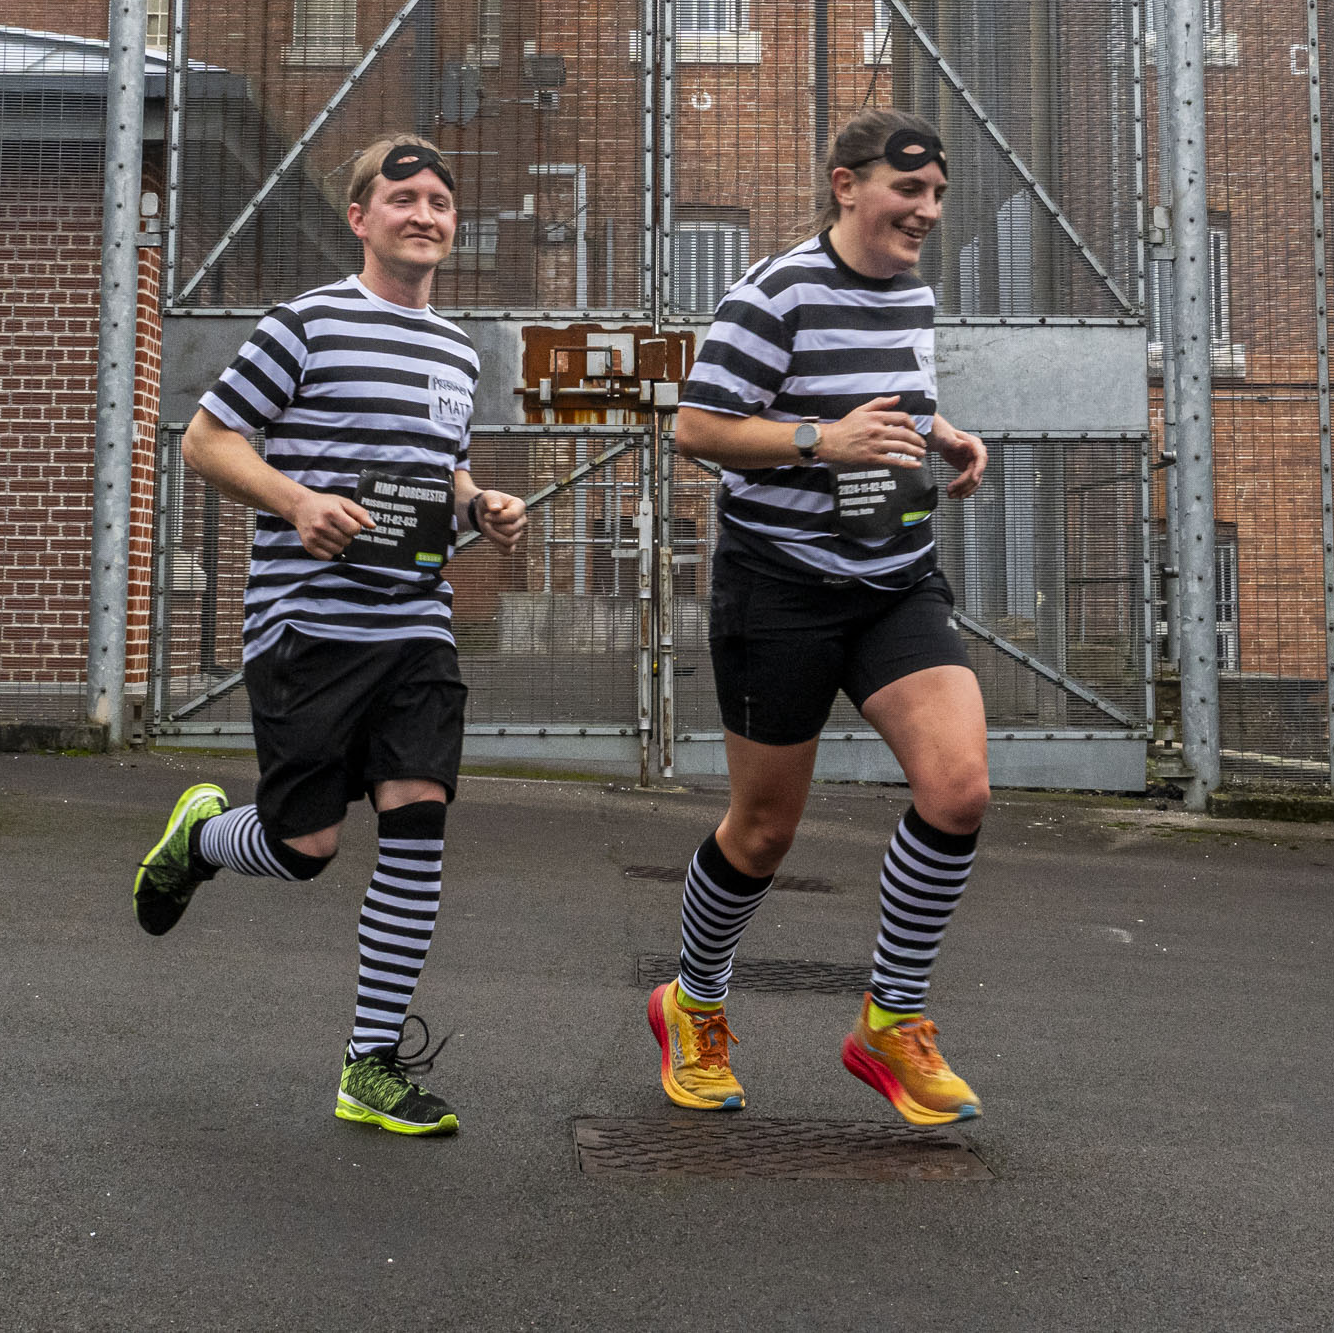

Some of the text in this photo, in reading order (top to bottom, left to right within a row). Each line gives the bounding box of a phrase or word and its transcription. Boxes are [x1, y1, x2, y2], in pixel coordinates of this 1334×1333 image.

[374, 481, 447, 504] HMP DORCHESTER
[361, 496, 392, 511] PRISONER
[369, 510, 418, 527] 24-11-02-032
